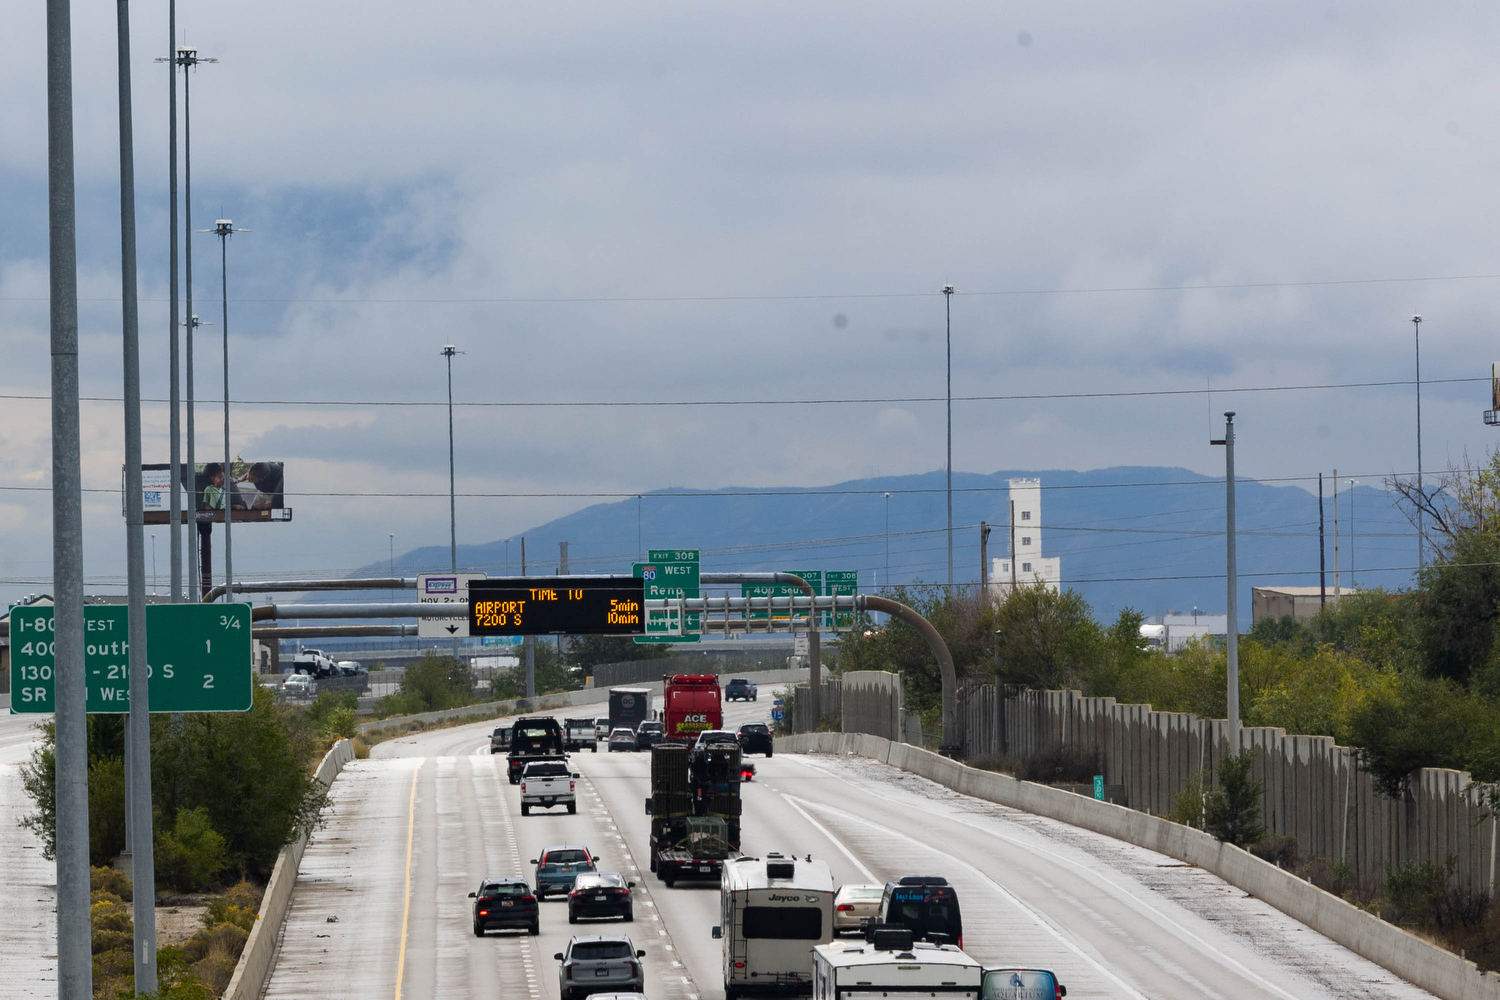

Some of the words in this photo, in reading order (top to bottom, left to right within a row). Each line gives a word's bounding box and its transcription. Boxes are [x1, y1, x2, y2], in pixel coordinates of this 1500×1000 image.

[674, 552, 694, 560] 308
[643, 571, 656, 580] 80
[664, 566, 691, 575] WEST
[529, 589, 558, 601] TIME
[475, 601, 526, 614] AIRPORT
[610, 600, 639, 612] 5min
[220, 615, 241, 630] 3/4
[475, 614, 507, 626] 7200
[514, 614, 522, 626] S
[607, 612, 639, 624] 10min
[83, 618, 115, 631] EST
[86, 641, 129, 655] outh
[205, 639, 211, 654] 1
[20, 665, 55, 680] 130
[163, 664, 174, 678] S
[203, 674, 215, 689] 2
[21, 687, 47, 702] SR
[768, 894, 800, 903] Jayco
[992, 991, 1044, 1000] AQUARIUM
